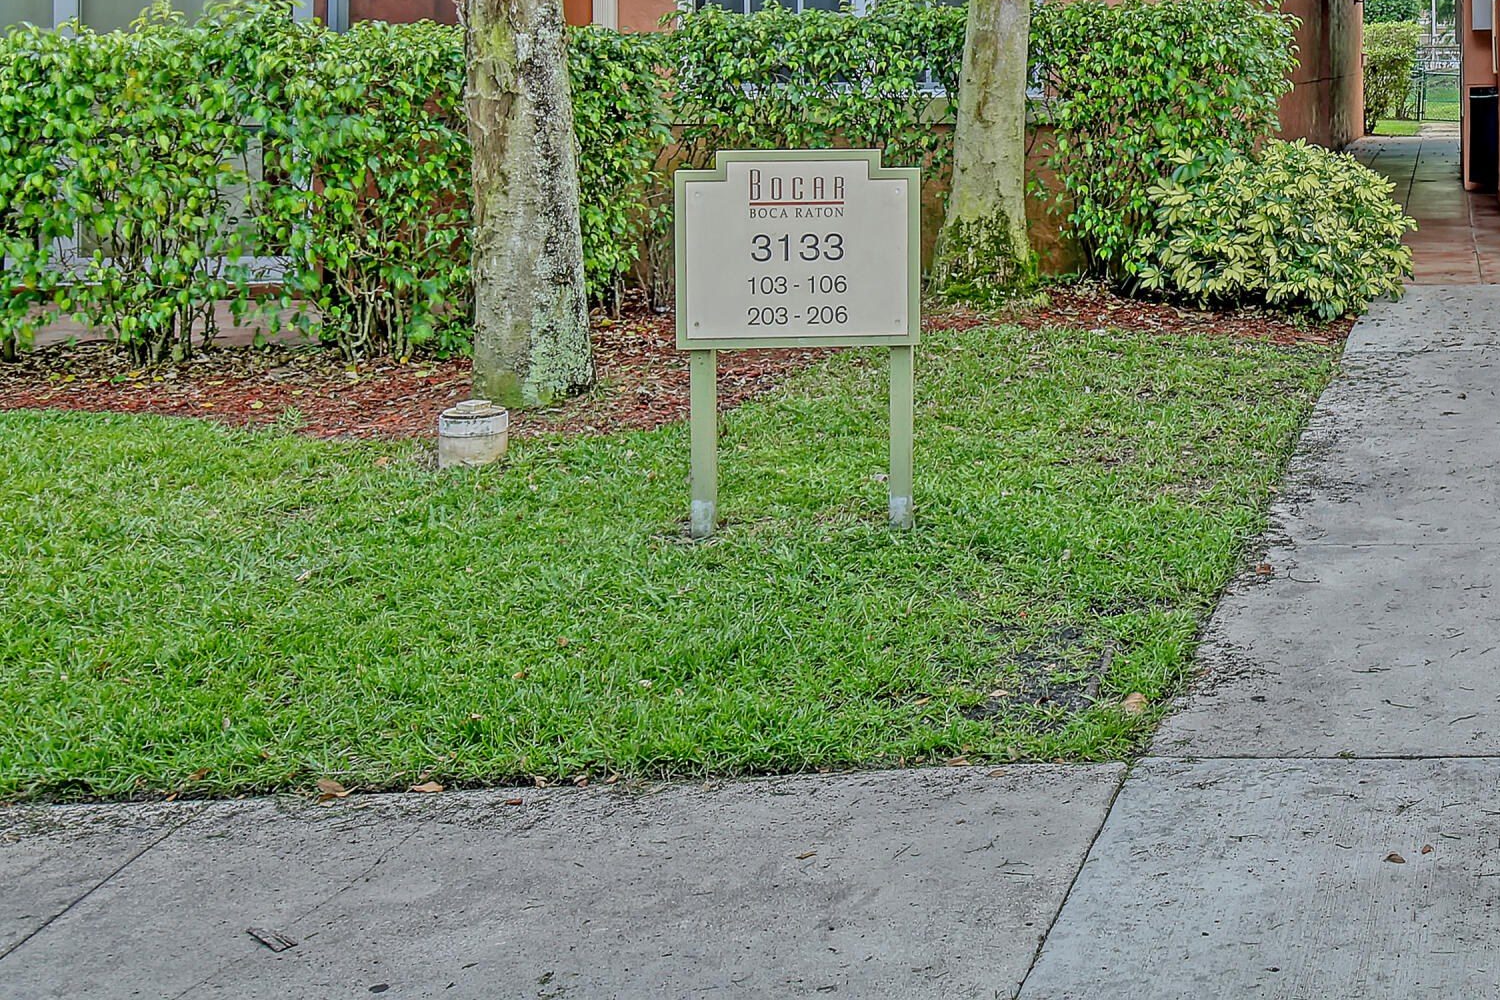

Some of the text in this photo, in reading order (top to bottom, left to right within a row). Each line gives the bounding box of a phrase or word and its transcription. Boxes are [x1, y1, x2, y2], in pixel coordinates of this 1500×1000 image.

[749, 169, 845, 200] BOCAR
[749, 207, 844, 219] BOCA RATON
[751, 233, 844, 262] 3133
[747, 276, 788, 295] 103
[807, 275, 848, 294] 106
[747, 307, 789, 326] 203
[807, 306, 848, 325] 206
